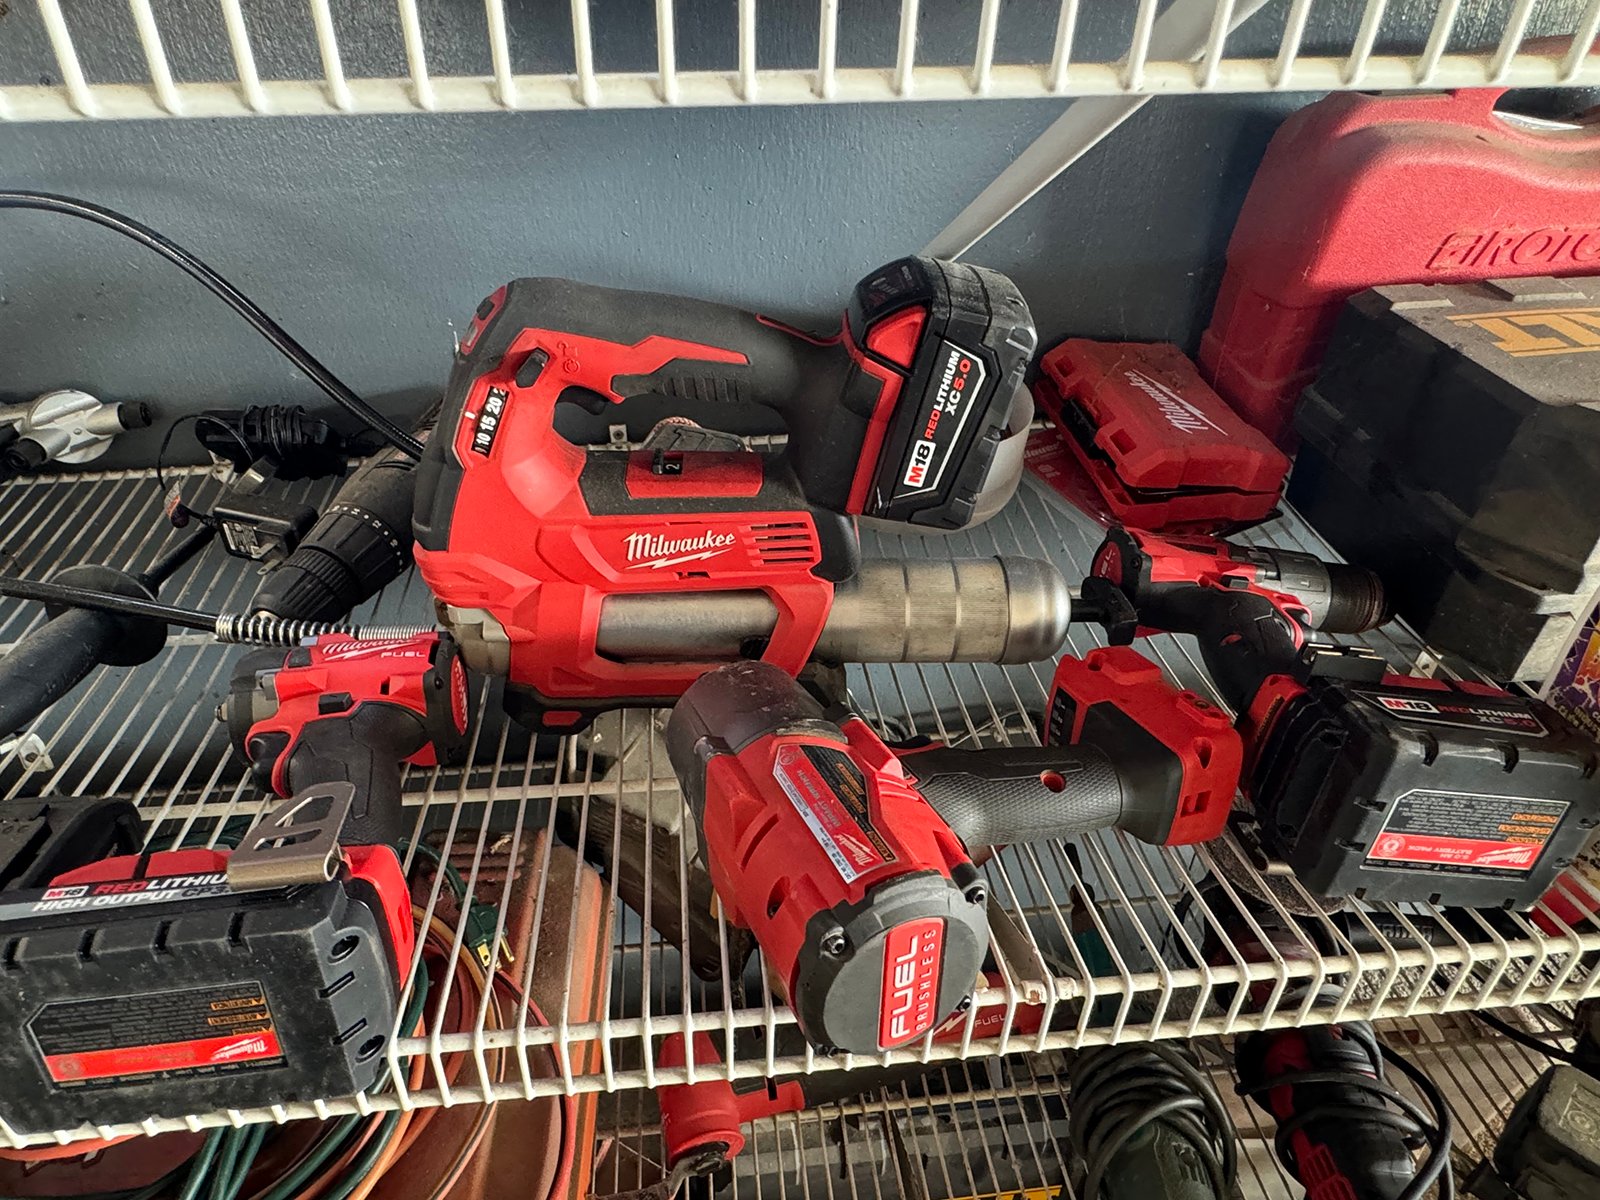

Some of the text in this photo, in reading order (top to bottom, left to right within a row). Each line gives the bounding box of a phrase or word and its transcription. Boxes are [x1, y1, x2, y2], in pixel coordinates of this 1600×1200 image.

[945, 358, 971, 417] XC5.0
[485, 396, 503, 415] 20
[1124, 370, 1209, 435] Milwaukee
[479, 415, 497, 431] 15
[908, 350, 961, 484] M18 REDLITHIUM
[476, 432, 492, 446] 10
[622, 529, 737, 562] Milwaukee
[380, 650, 426, 658] FUEL
[1385, 698, 1532, 720] M18 REDLITHIUM
[1478, 715, 1538, 728] XC5.0
[32, 885, 230, 912] HIGH OUTPUT CP3.
[47, 873, 227, 899] M18 REDLITHIU
[890, 935, 919, 1039] FUEL
[915, 929, 937, 1031] BRUSHLESS
[212, 1039, 267, 1061] Milwaukee
